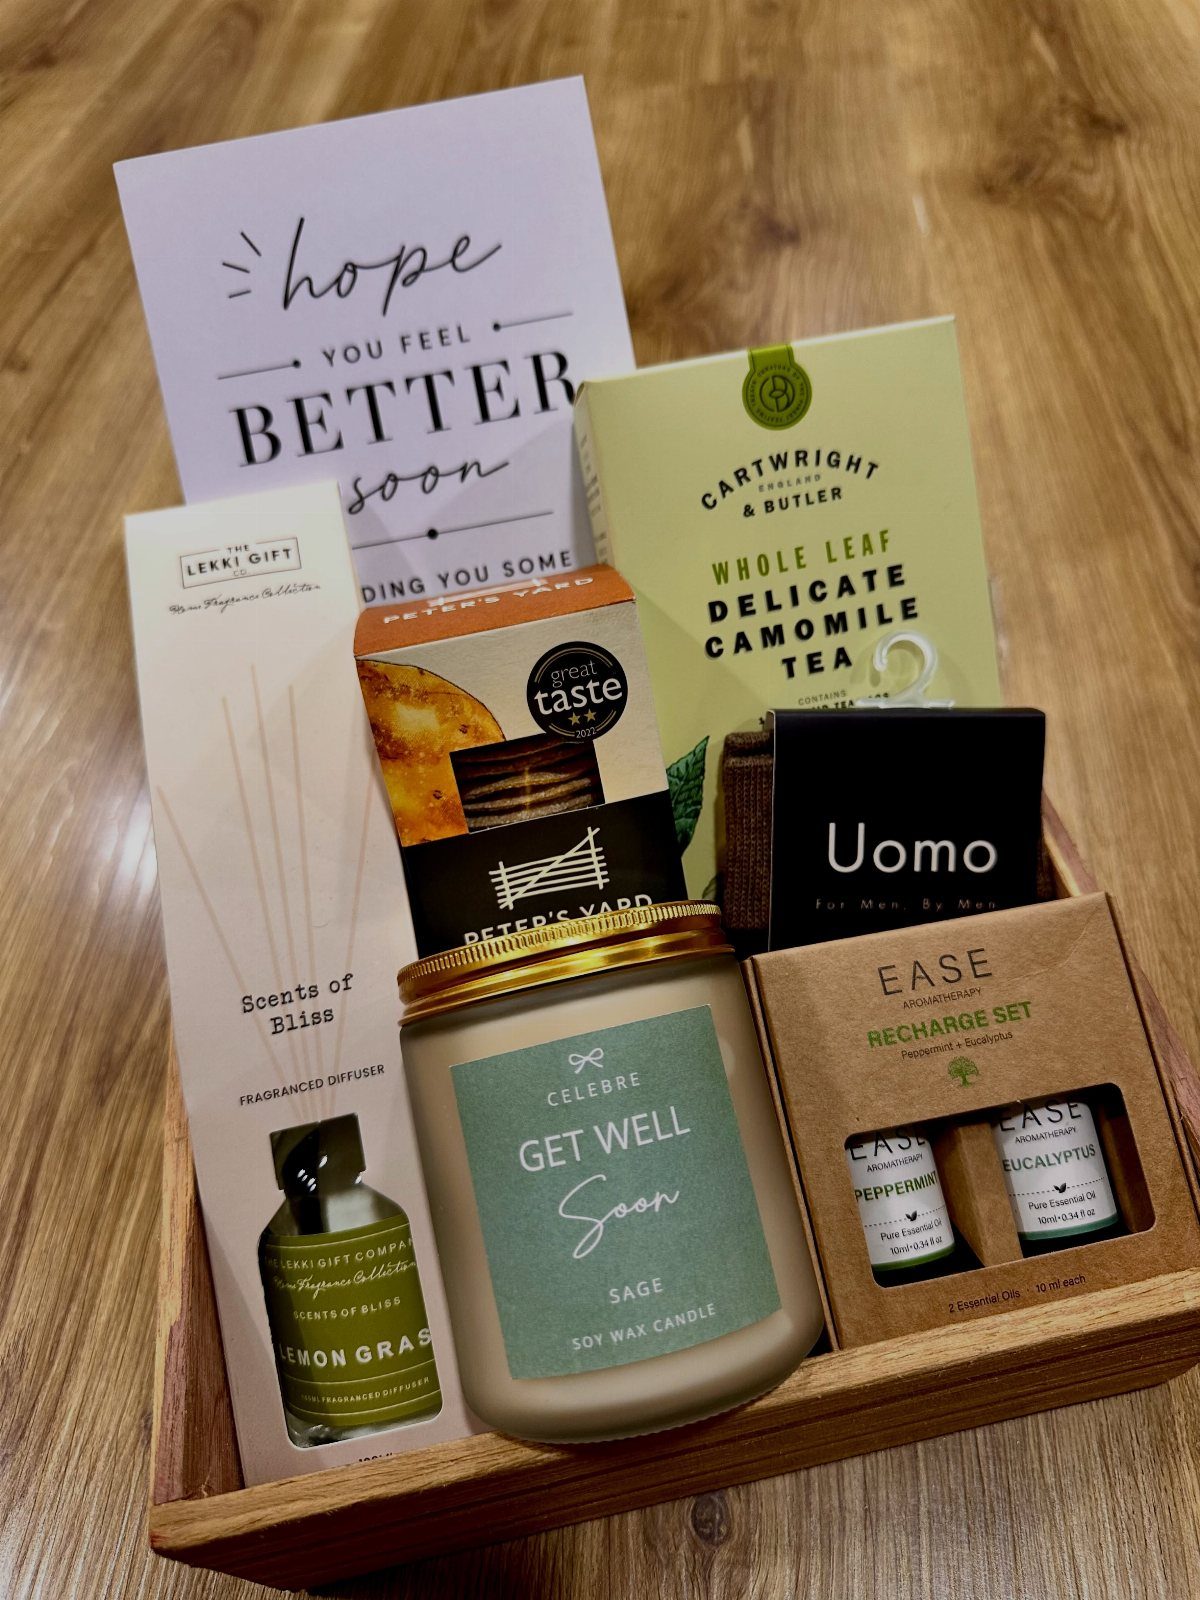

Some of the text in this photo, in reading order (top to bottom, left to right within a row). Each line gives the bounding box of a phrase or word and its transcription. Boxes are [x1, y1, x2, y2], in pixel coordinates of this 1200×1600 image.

[284, 217, 502, 317] hope
[322, 325, 471, 368] YOU FEEL
[230, 350, 576, 467] BETTER
[348, 459, 509, 515] soon
[701, 449, 879, 510] CARTWRIGHT
[758, 474, 822, 493] ENGLAND
[742, 487, 843, 518] & BUTLER
[187, 549, 292, 576] LEKKI GIFT
[227, 544, 249, 554] THE
[711, 529, 892, 586] WHOLE LEAF
[438, 565, 489, 589] YOU
[503, 551, 573, 577] SOME
[384, 577, 593, 624] PETER'S YARD
[708, 564, 907, 623] DELICATE
[704, 597, 919, 659] CAMOMILE
[551, 660, 598, 688] great
[782, 647, 853, 679] TEA
[533, 676, 623, 715] taste
[798, 690, 847, 706] CONTAINS
[575, 726, 597, 739] 2022
[828, 822, 997, 873] Uomo
[815, 898, 845, 910] For
[923, 899, 942, 912] By
[958, 899, 996, 909] Men
[878, 948, 992, 995] EASE
[242, 973, 353, 1013] Scents of
[903, 987, 982, 1009] AROMATHERAPY
[270, 1008, 334, 1035] Bliss
[867, 1001, 1031, 1048] RECHARGE SET
[901, 1041, 953, 1059] Peppermint
[965, 1031, 1013, 1047] Eucalyptus
[240, 1064, 385, 1106] FRAGRANCED DIFFUSER
[547, 1072, 641, 1107] CELEBRE
[518, 1105, 691, 1172] GET WELL
[1015, 1126, 1077, 1144] AROMATHERAPY
[866, 1153, 923, 1173] AROMATHERAPY
[1003, 1144, 1096, 1172] EUCALYPTUS
[855, 1170, 938, 1203] PEPPERMINT
[1028, 1191, 1096, 1211] Pure Essential Oil
[558, 1174, 680, 1259] Soon
[880, 1229, 900, 1242] Pure
[901, 1222, 934, 1237] Essential
[935, 1236, 942, 1244] oz
[281, 1259, 314, 1270] LEKKI
[318, 1253, 351, 1268] GIFT
[297, 1275, 351, 1299] Fragrance
[609, 1277, 664, 1304] SAGE
[949, 1274, 1086, 1313] 2 Essential Oils 10 ml each
[293, 1296, 401, 1321] SCENTS OF BLISS
[571, 1303, 717, 1350] SOY WAX CANDLE
[279, 1343, 347, 1367] LEMON
[321, 1391, 381, 1403] FRAGRANCED
[383, 1376, 430, 1396] DIFFUSER
